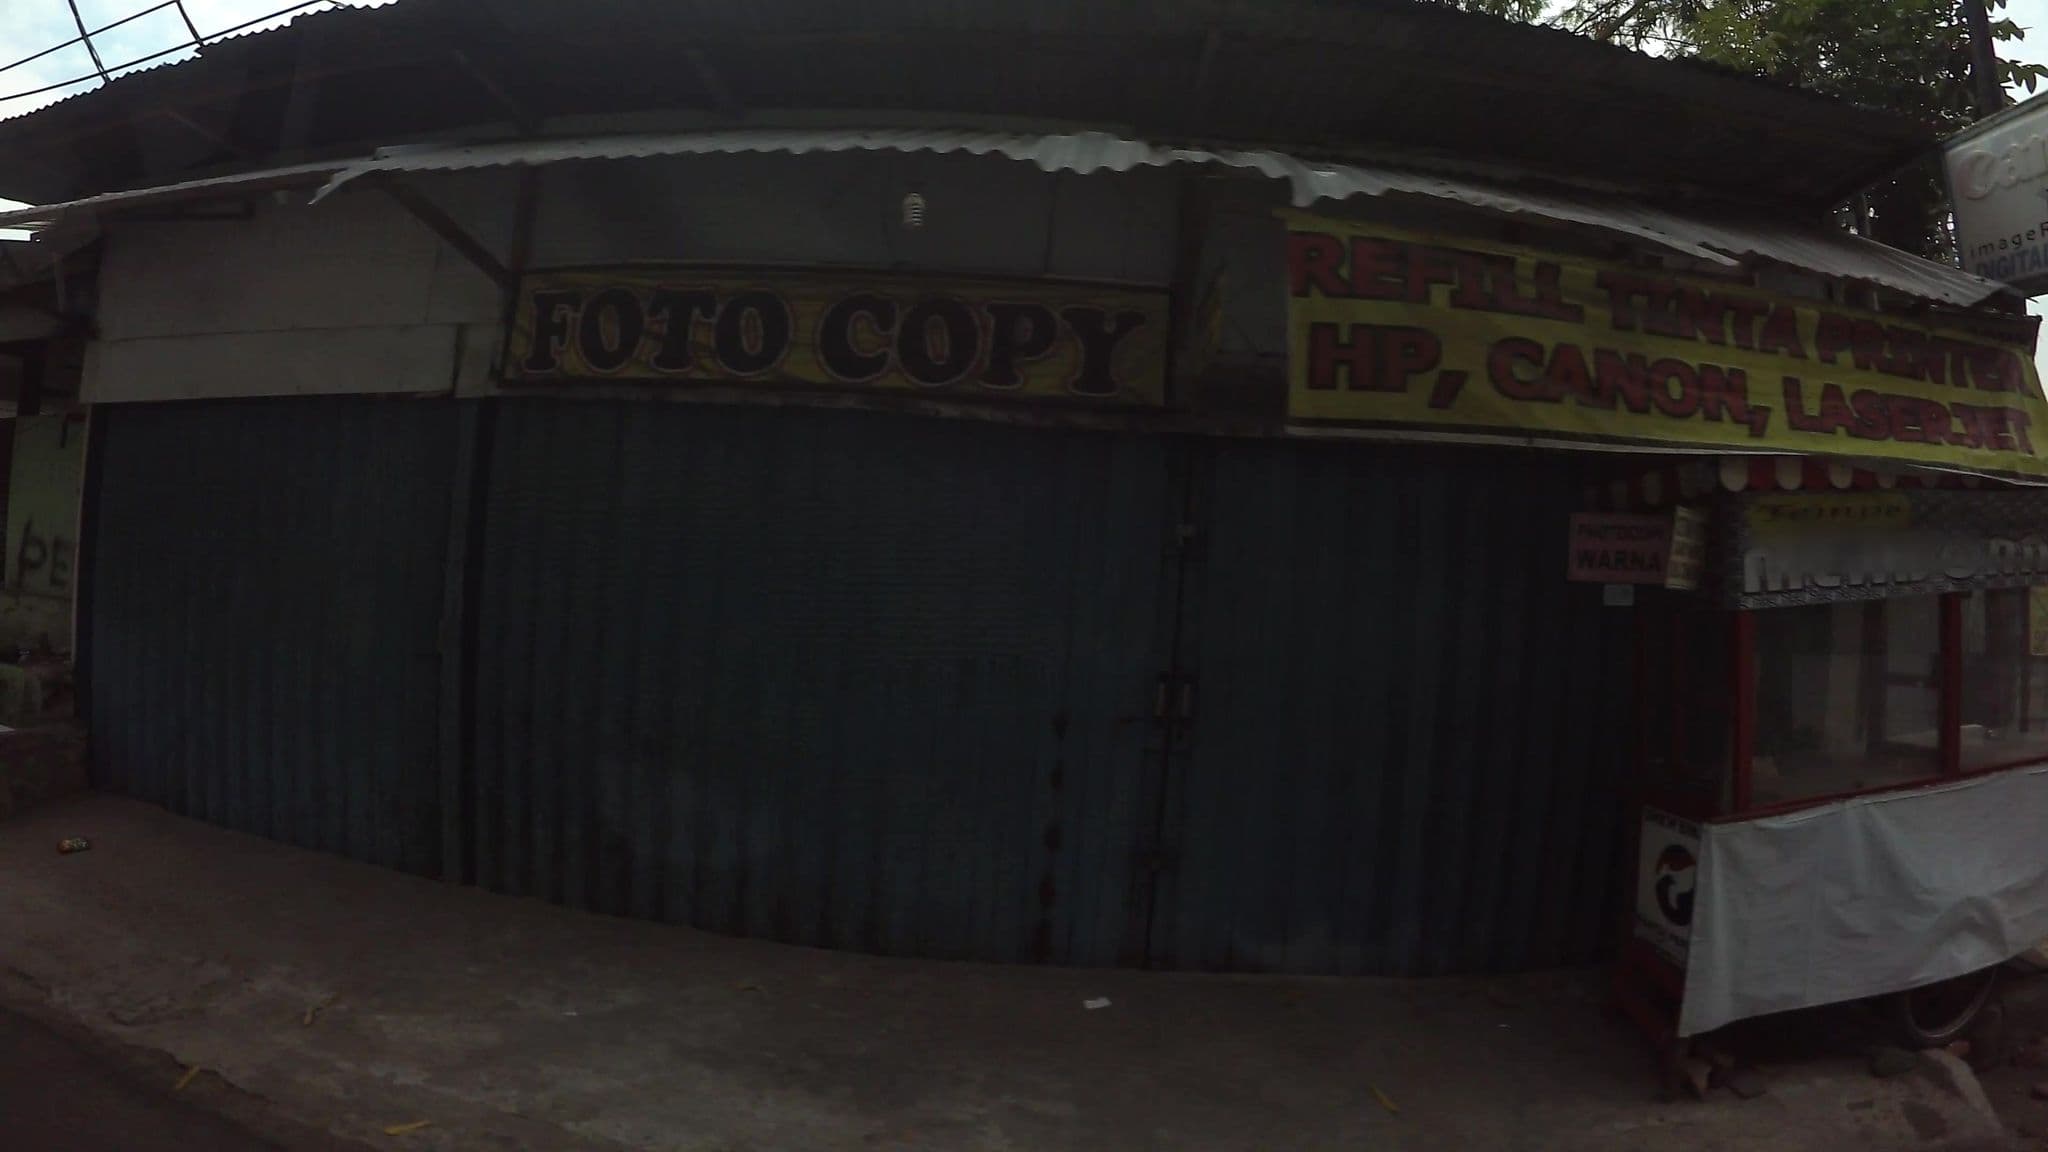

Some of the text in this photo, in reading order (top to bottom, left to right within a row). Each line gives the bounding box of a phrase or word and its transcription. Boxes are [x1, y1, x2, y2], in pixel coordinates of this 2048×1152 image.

[523, 286, 1147, 397] FOTO COPY
[1287, 230, 2037, 399] REFILL TINTA PRINTER
[1308, 321, 2034, 455] HP, CANON, LASERJET
[1577, 549, 1662, 573] WARNA
